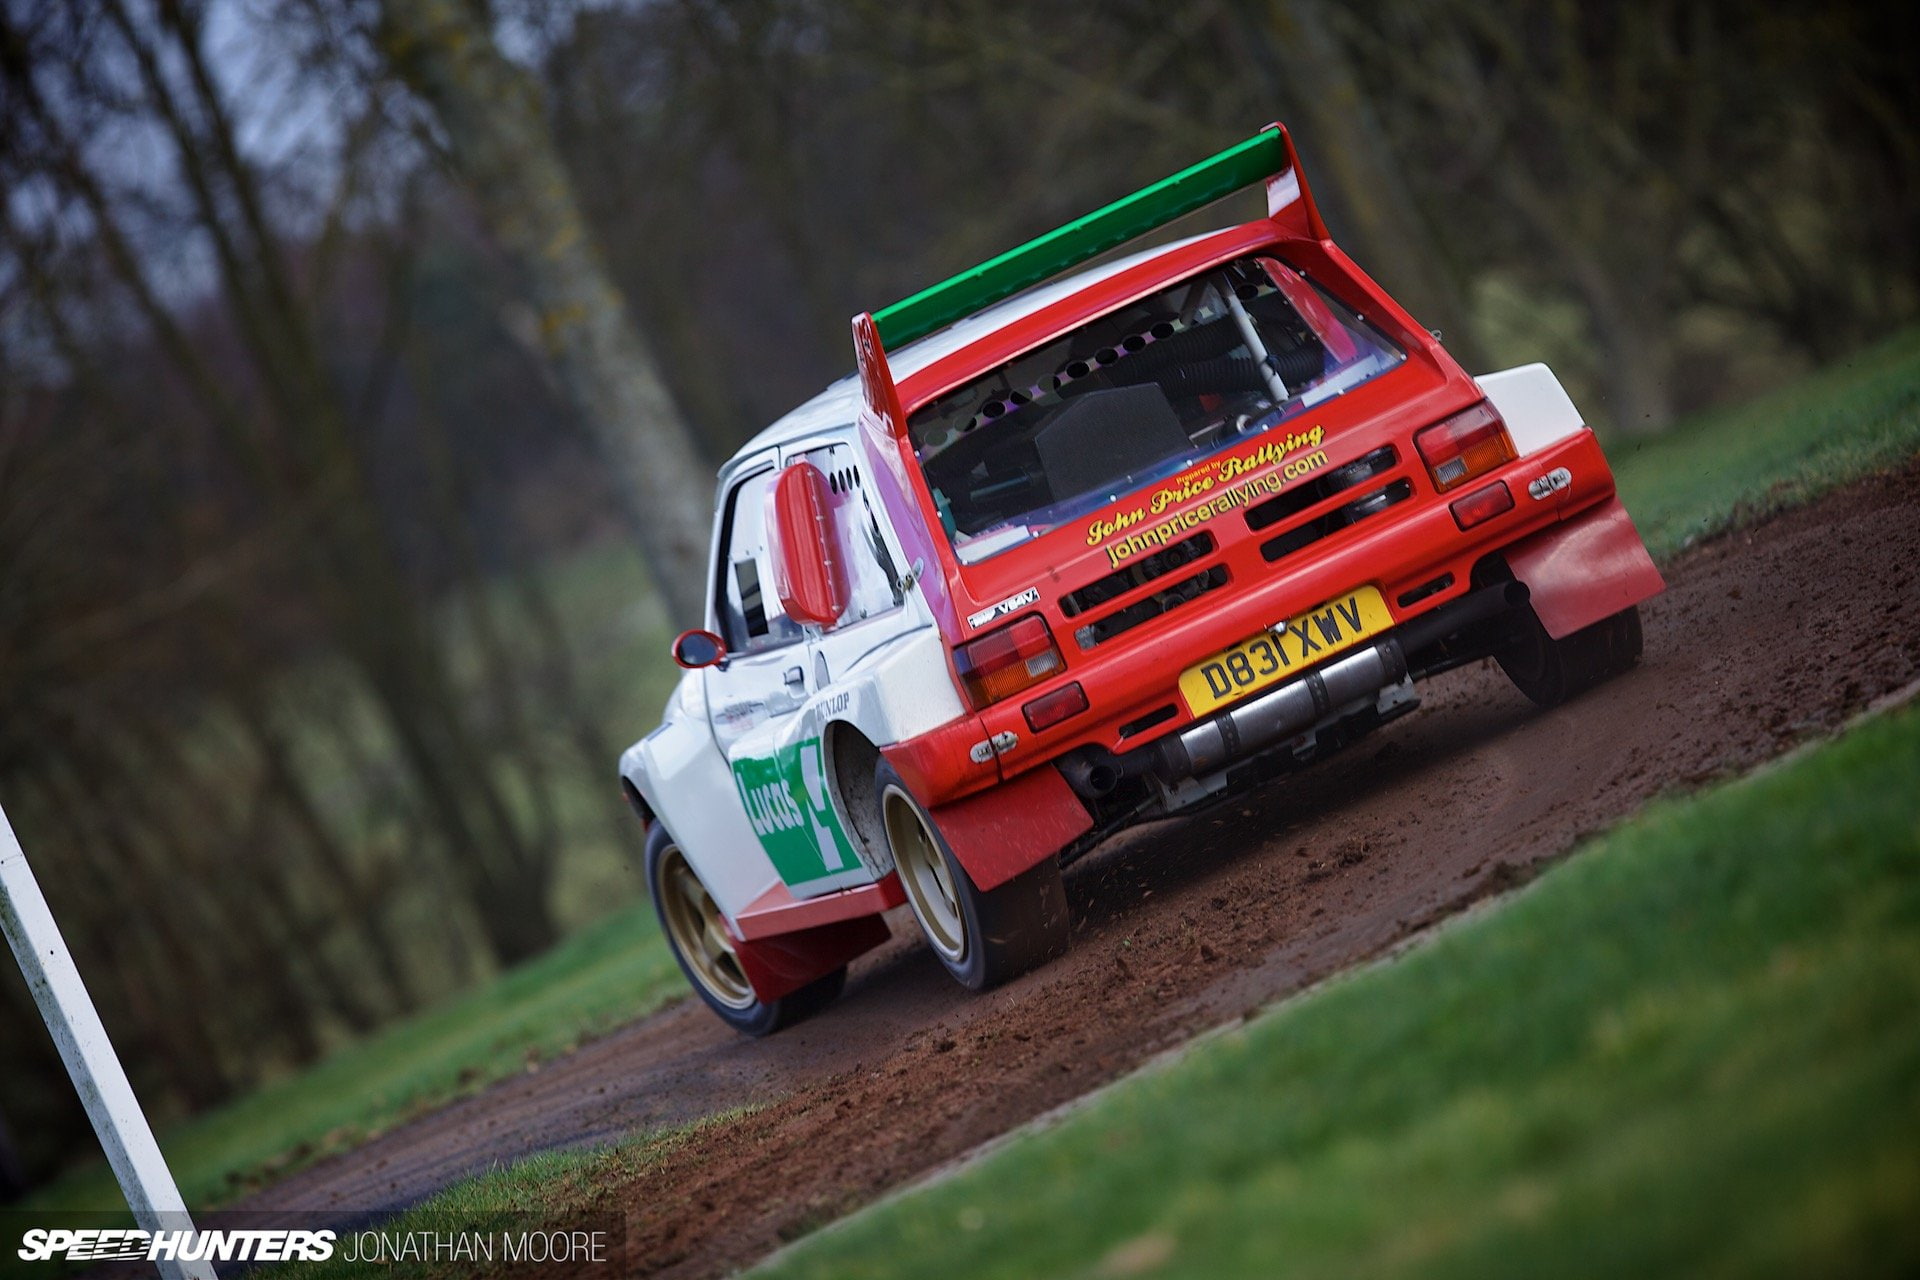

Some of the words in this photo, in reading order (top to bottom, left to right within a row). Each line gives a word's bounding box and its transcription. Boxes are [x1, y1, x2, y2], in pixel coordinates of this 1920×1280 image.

[1086, 505, 1146, 546] John
[1150, 478, 1215, 515] Price
[1218, 424, 1325, 482] Rallying
[1106, 450, 1328, 569] johnpricerallying.com
[1176, 464, 1211, 484] Prepared
[1210, 460, 1221, 473] by
[1200, 634, 1290, 700] D831
[1289, 596, 1363, 658] XWV
[815, 691, 850, 722] DUNLOP
[735, 771, 805, 837] Lucas
